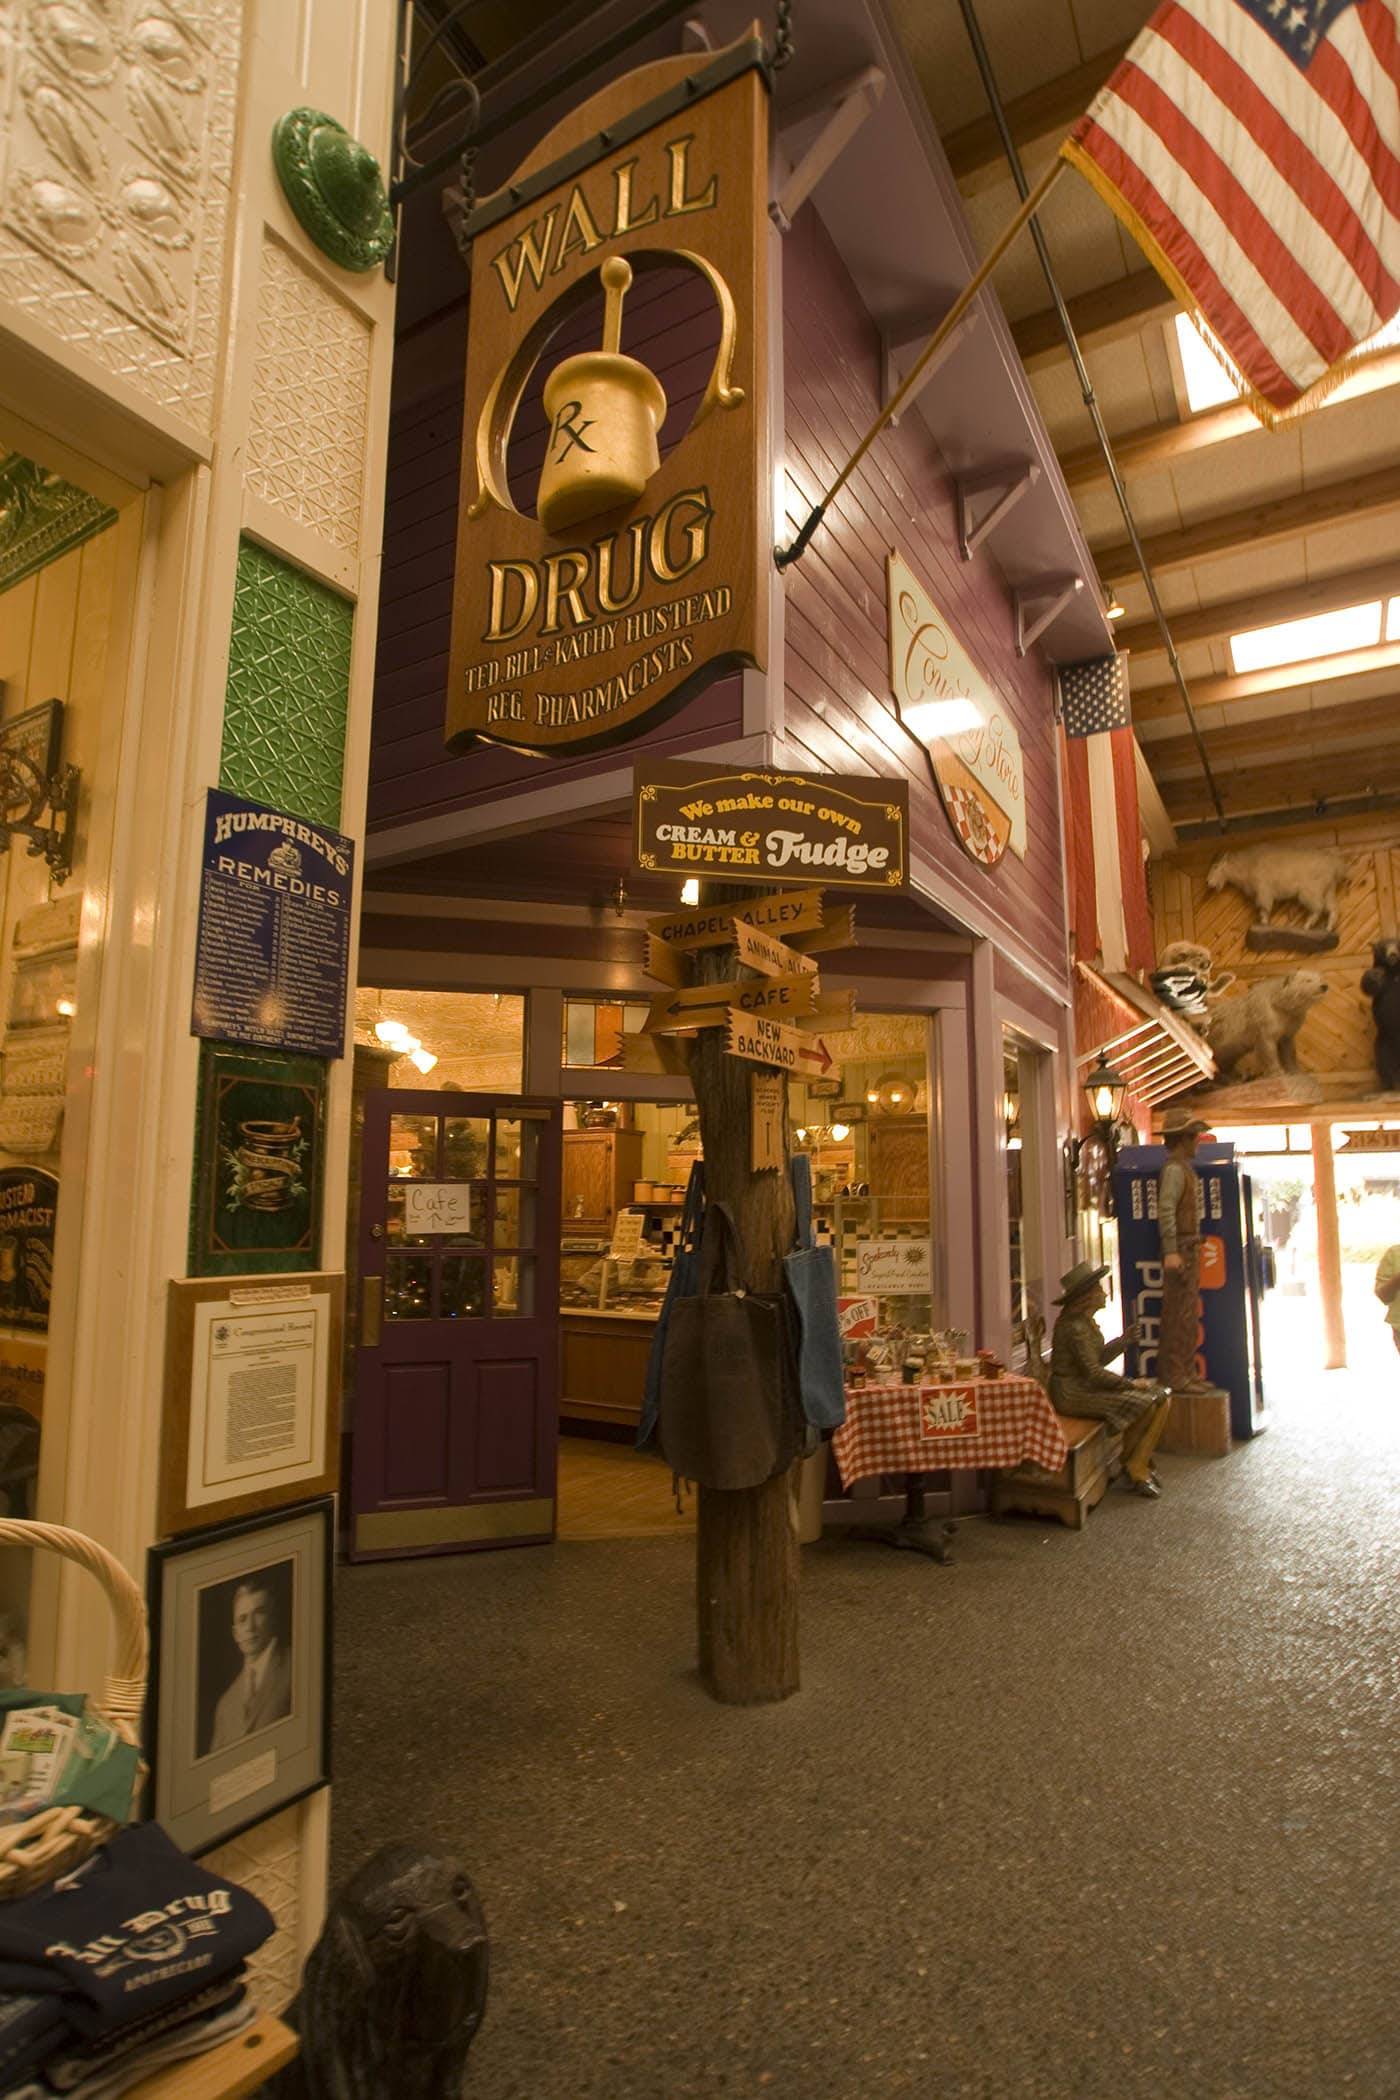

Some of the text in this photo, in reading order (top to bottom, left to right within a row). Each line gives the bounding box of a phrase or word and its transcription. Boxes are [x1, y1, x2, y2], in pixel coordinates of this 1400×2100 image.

[490, 134, 718, 312] WALL
[482, 485, 714, 643] DRUG
[504, 644, 543, 683] BILL
[553, 618, 619, 667] KATHY
[624, 585, 732, 646] HUSTEAD
[486, 635, 695, 728] REG. PHARMACISTS
[985, 714, 1019, 801] Store
[678, 793, 863, 836] We make our own
[655, 824, 761, 848] CREAM &
[671, 842, 761, 865] BUTTER
[765, 829, 889, 875] Fudge
[218, 855, 340, 906] REMEDIES
[661, 902, 804, 942] CHAPEL ALLEY
[746, 938, 783, 969] ANIMAL
[739, 986, 790, 1010] CAFE
[757, 1019, 781, 1041] NEW
[738, 1037, 796, 1066] BACKYARD
[412, 1188, 458, 1211] Cafe
[851, 1302, 869, 1321] OFF
[928, 1399, 965, 1425] SALE
[119, 1889, 233, 1934] Drug
